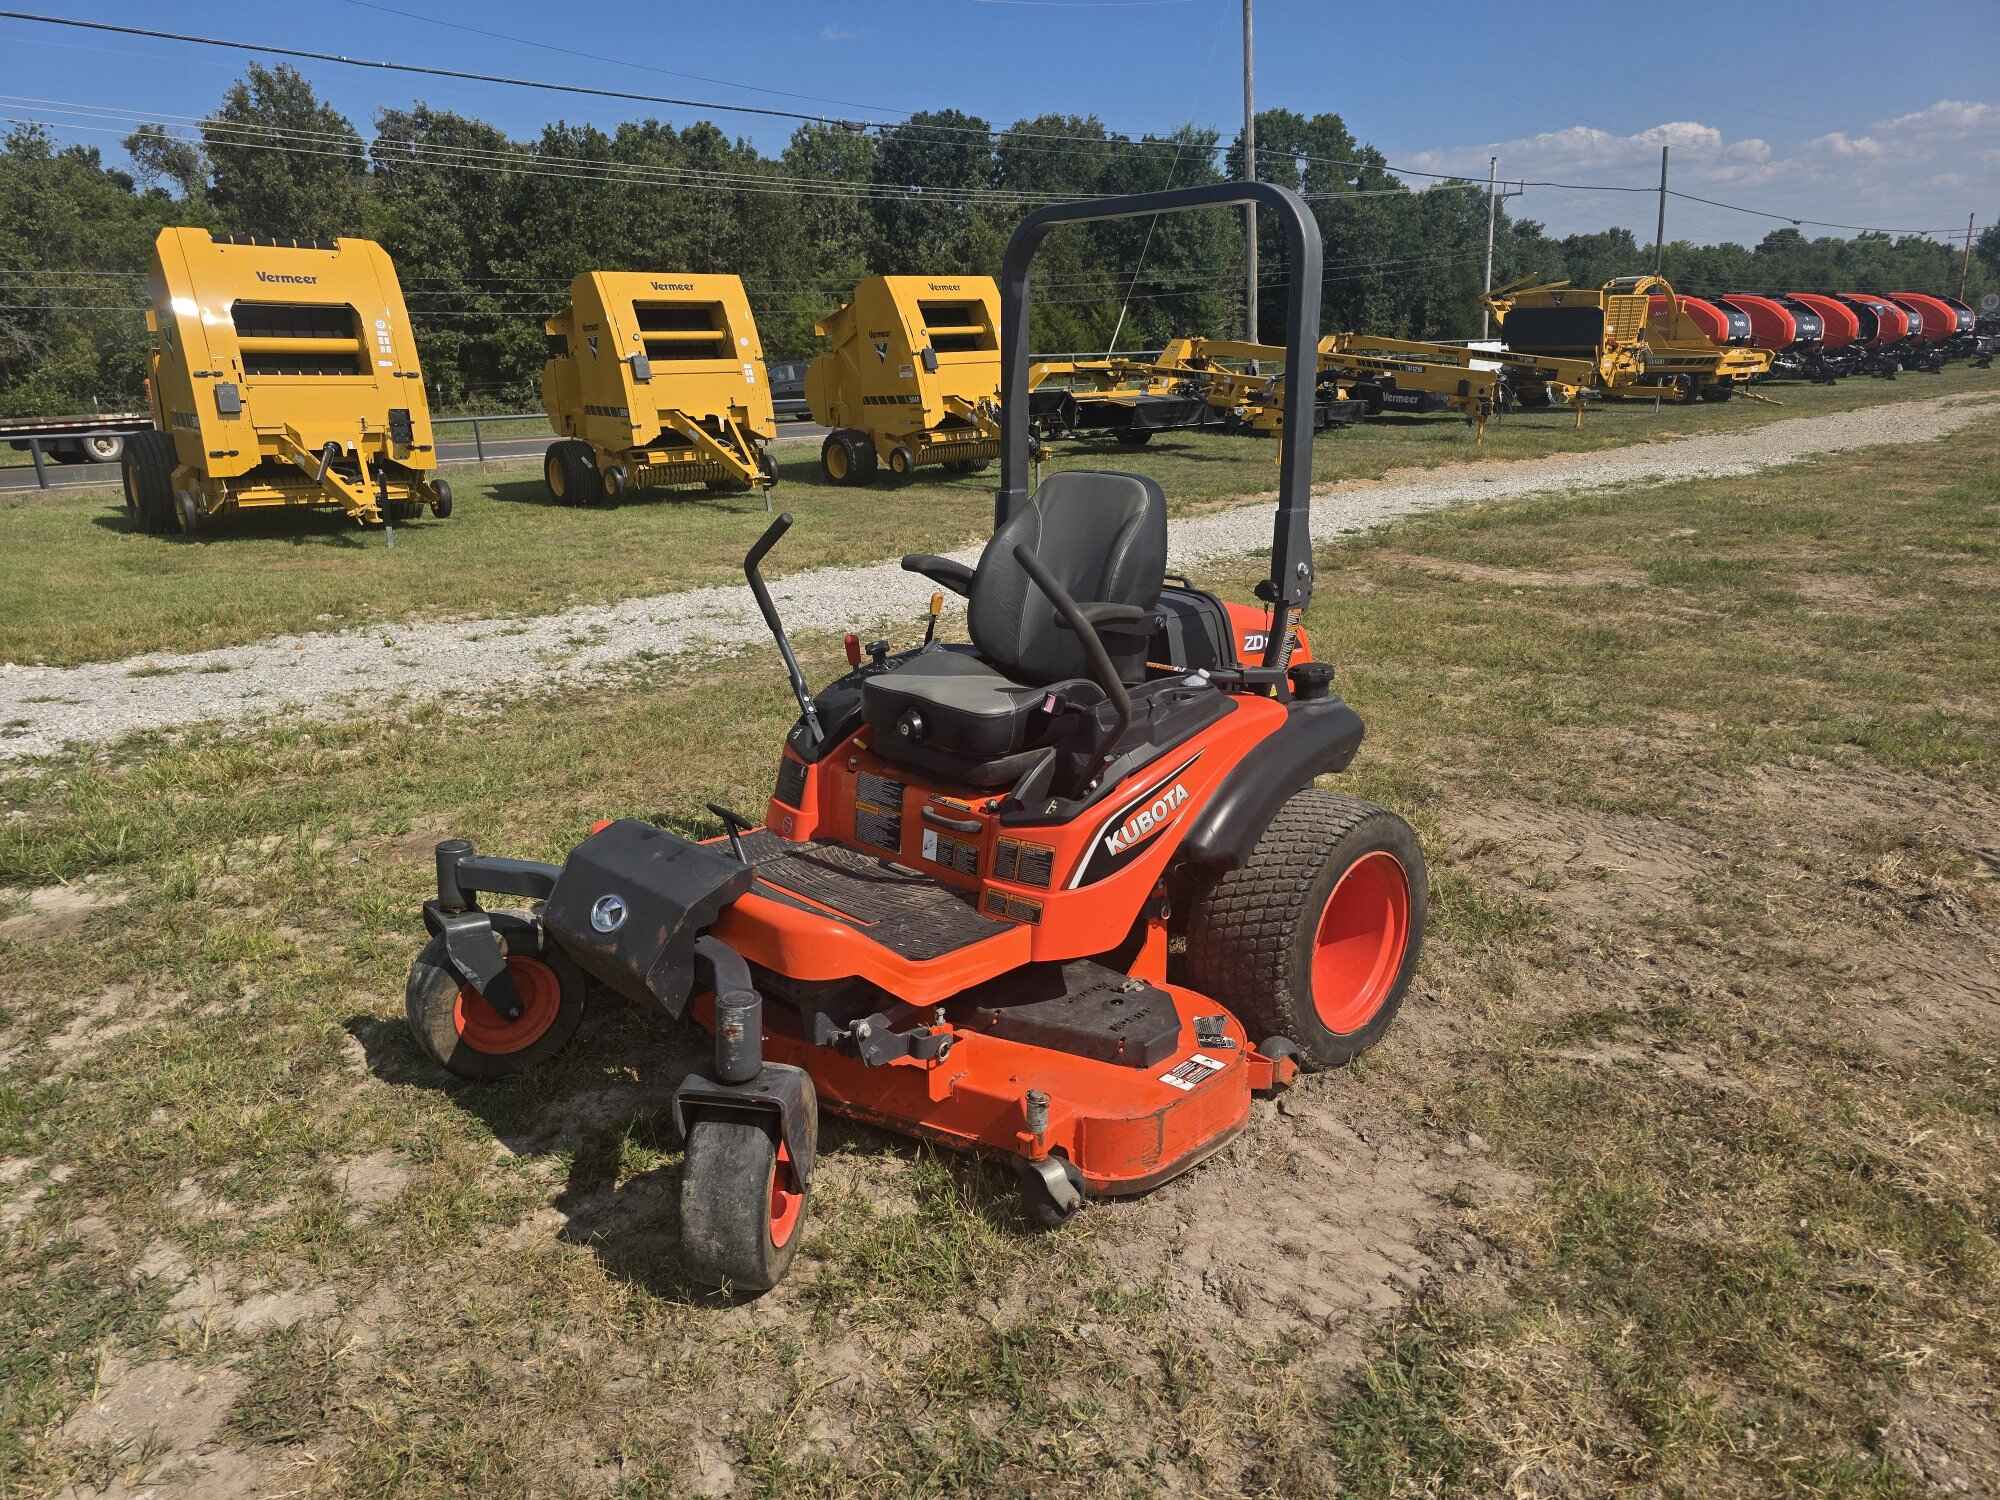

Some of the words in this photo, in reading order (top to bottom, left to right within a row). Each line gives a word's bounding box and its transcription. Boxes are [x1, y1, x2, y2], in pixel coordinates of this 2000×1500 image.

[255, 271, 317, 284] Vermeer
[650, 281, 694, 291] Vermeer
[928, 282, 960, 291] Vermeer
[1382, 391, 1419, 404] Vermeer
[1105, 784, 1189, 856] KUBOTA
